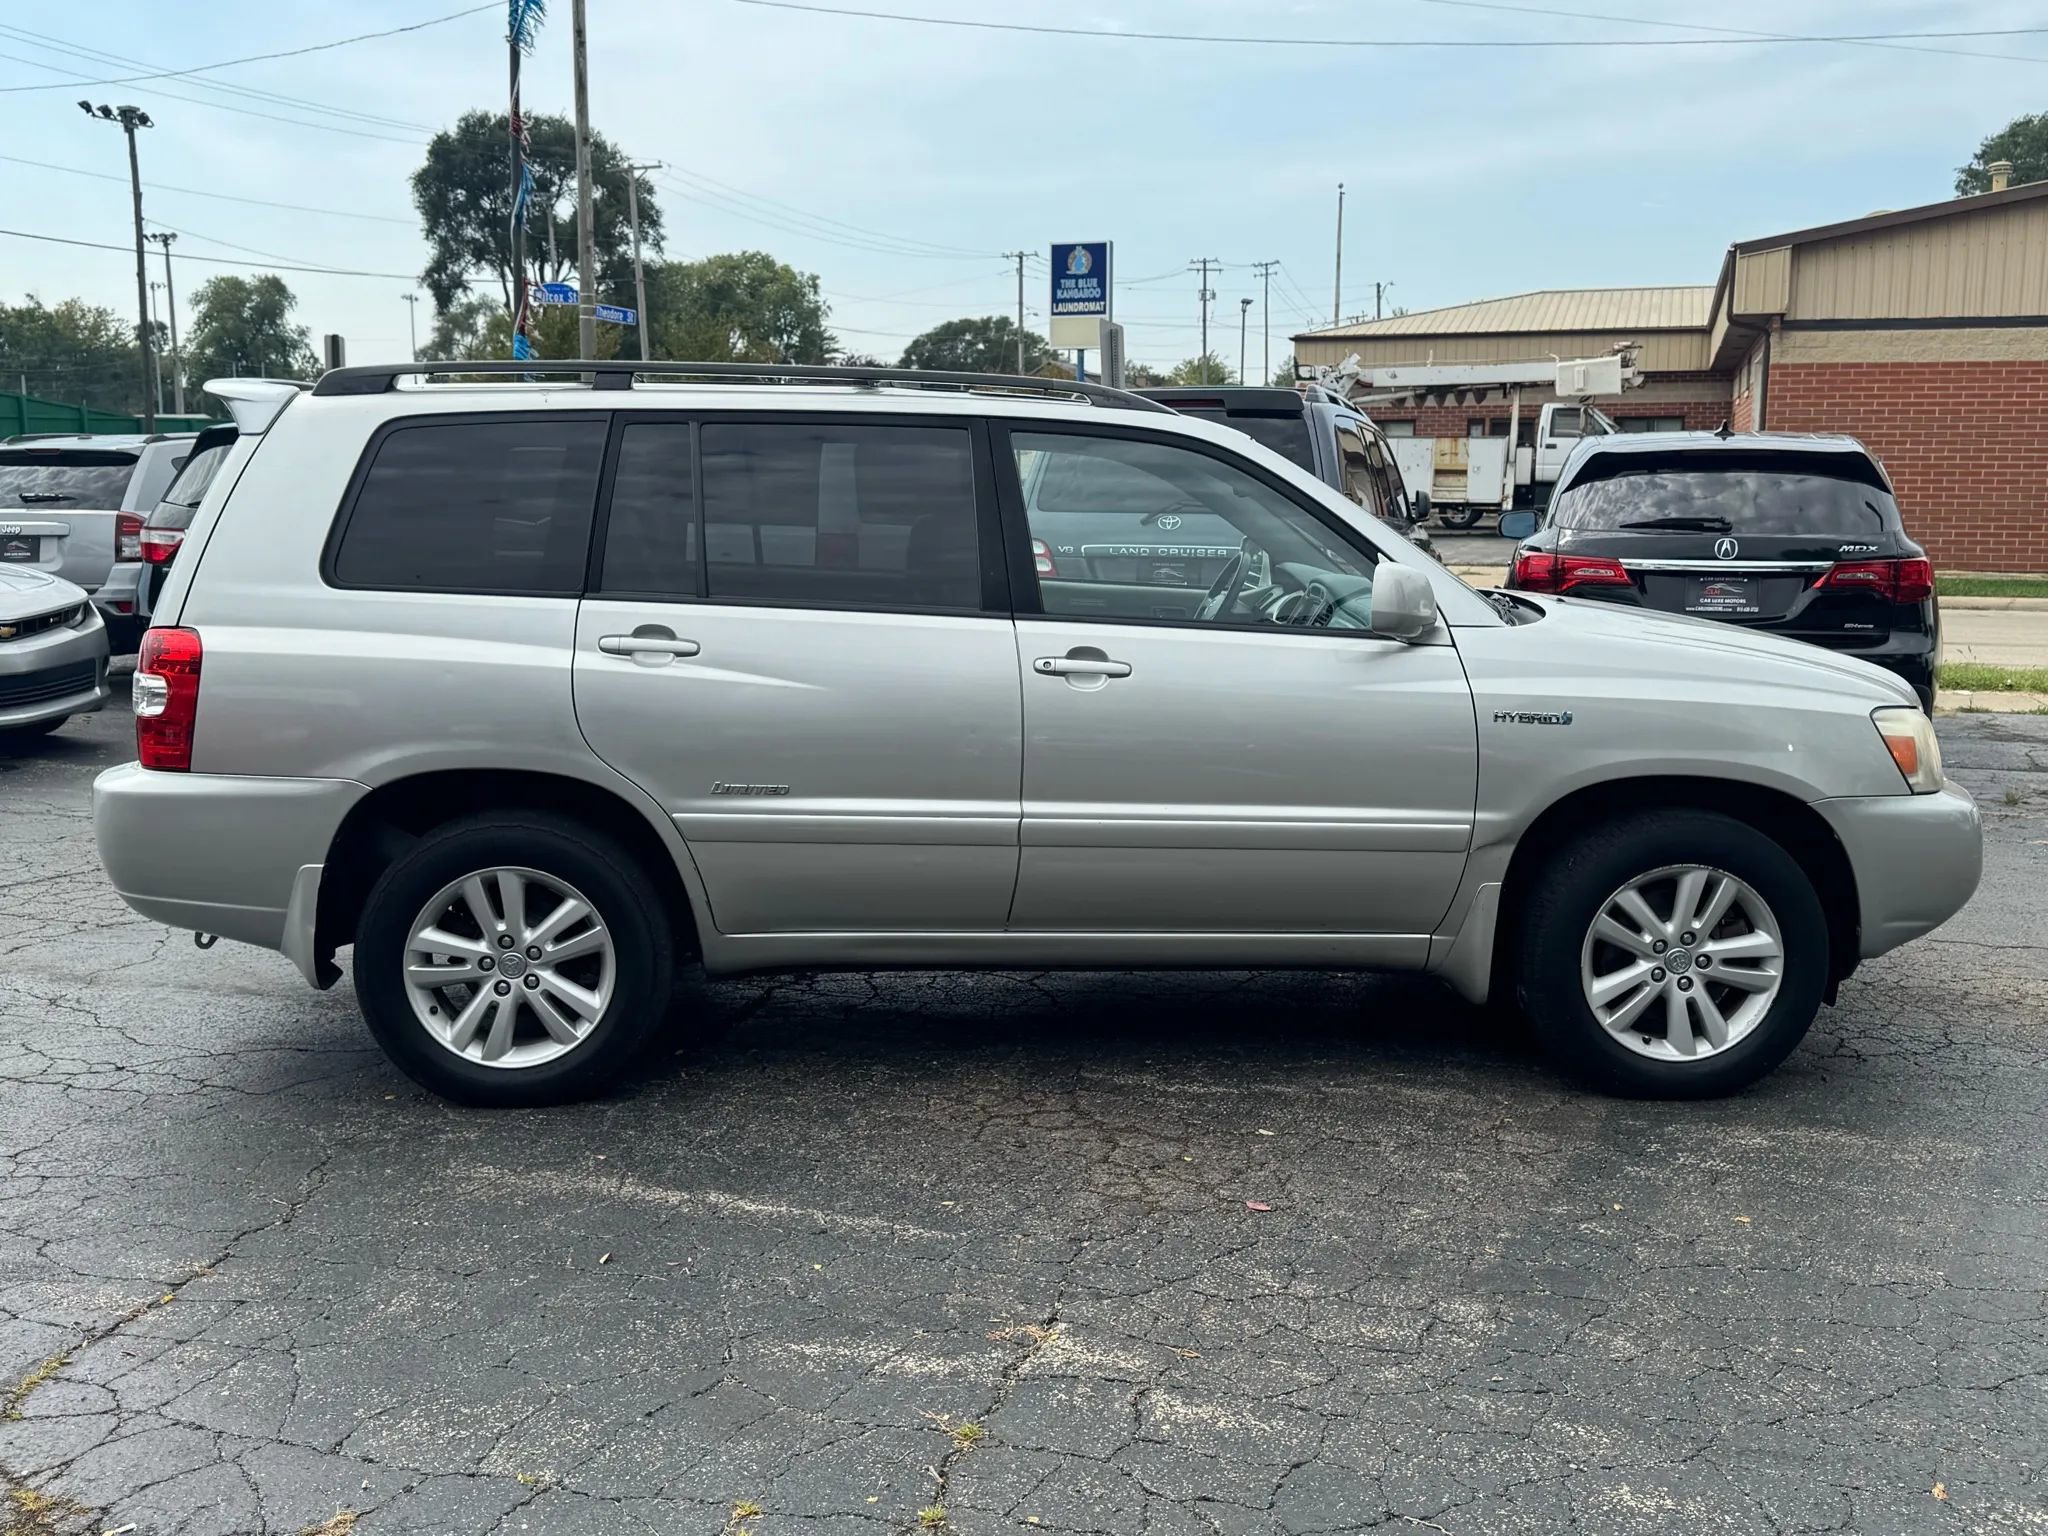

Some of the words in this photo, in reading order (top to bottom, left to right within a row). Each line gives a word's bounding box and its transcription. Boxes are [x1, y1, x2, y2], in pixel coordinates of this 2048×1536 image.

[1060, 278, 1076, 288] THE
[1077, 278, 1098, 288] BLUE
[568, 291, 577, 303] St
[1056, 287, 1101, 299] KANGAROO
[1053, 301, 1105, 313] LAUNDROMAT
[1, 525, 21, 534] Jeep
[1058, 546, 1074, 554] V8
[1109, 547, 1150, 556] LAND
[1158, 548, 1227, 557] CRUISER
[1493, 710, 1561, 725] HYBRID
